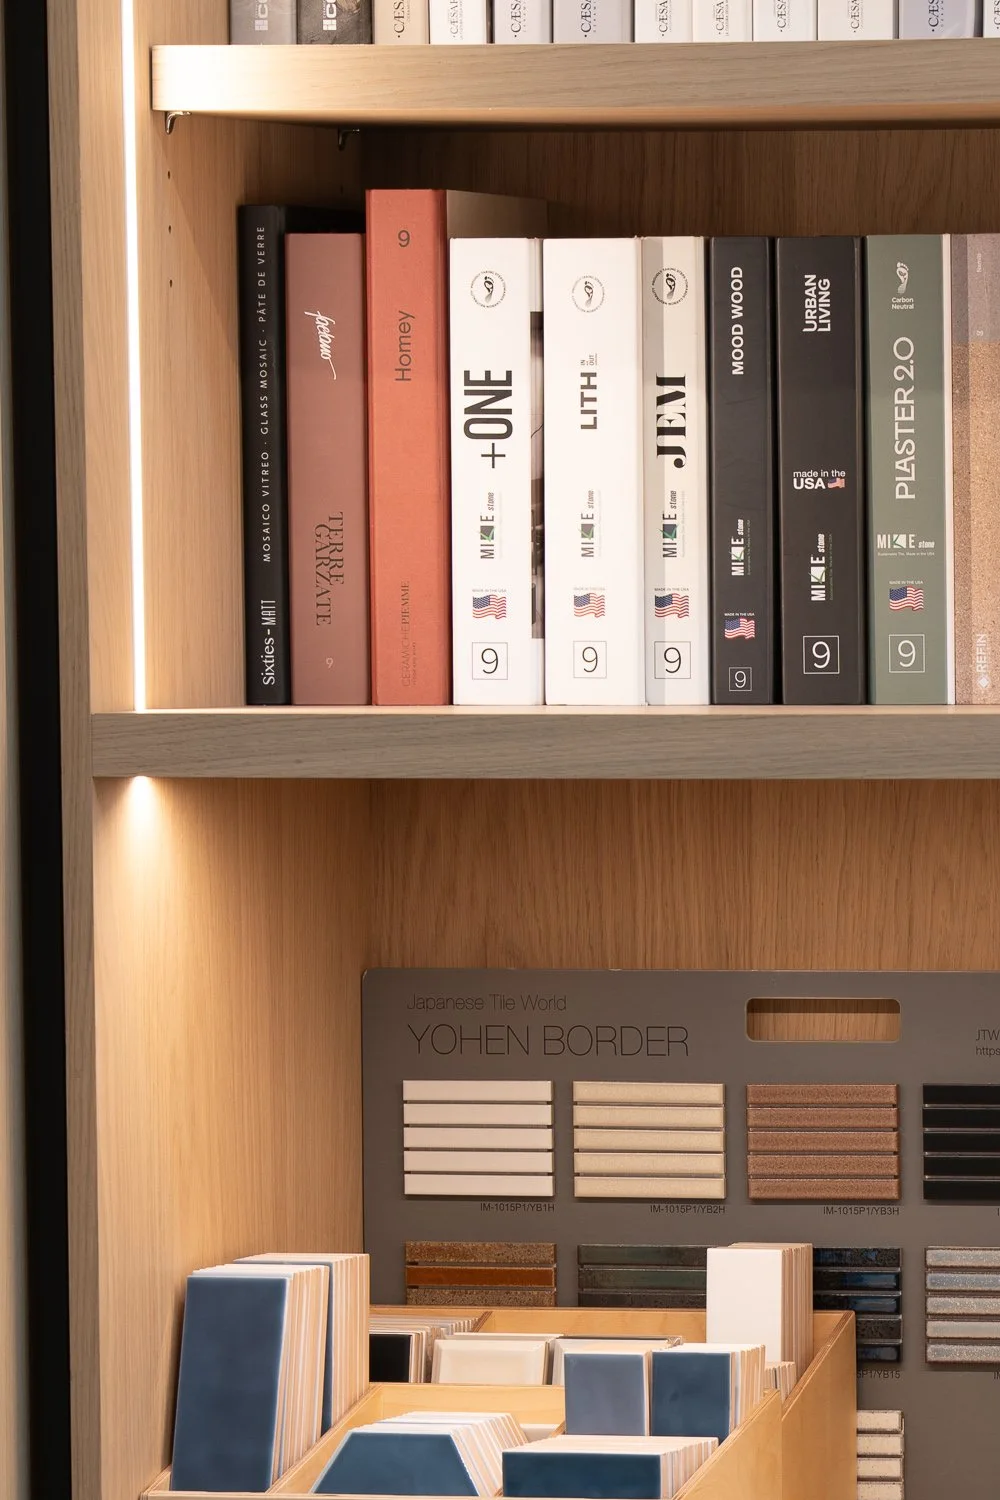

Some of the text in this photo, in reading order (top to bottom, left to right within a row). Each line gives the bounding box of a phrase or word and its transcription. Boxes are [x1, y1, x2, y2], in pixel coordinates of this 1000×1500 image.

[398, 230, 411, 248] 9
[257, 227, 266, 322] PÂTE DE VERRE
[731, 267, 744, 375] MOOD WOOD
[803, 274, 818, 333] URBAN
[818, 278, 831, 333] LIVING
[395, 310, 416, 382] Homey
[259, 340, 269, 435] GLASS MOSAIC
[580, 372, 598, 430] LITH
[656, 373, 687, 469] JEM
[893, 337, 916, 500] PLASTER 2.0
[793, 470, 846, 478] made in the
[793, 478, 826, 490] USA
[261, 452, 271, 562] MOSAICO VITREO
[487, 492, 495, 512] stone
[329, 512, 345, 585] TERRE
[314, 524, 334, 626] GARZATE
[262, 638, 275, 686] Sixties
[481, 648, 500, 674] 9
[582, 647, 598, 673] 9
[664, 647, 682, 673] 9
[812, 641, 831, 669] 9
[898, 640, 916, 668] 9
[976, 634, 988, 672] REFIN
[734, 671, 747, 689] 9
[407, 994, 567, 1013] Japanese Tile World
[408, 1024, 689, 1057] YOHEN BORDER
[975, 1029, 1000, 1042] JTW
